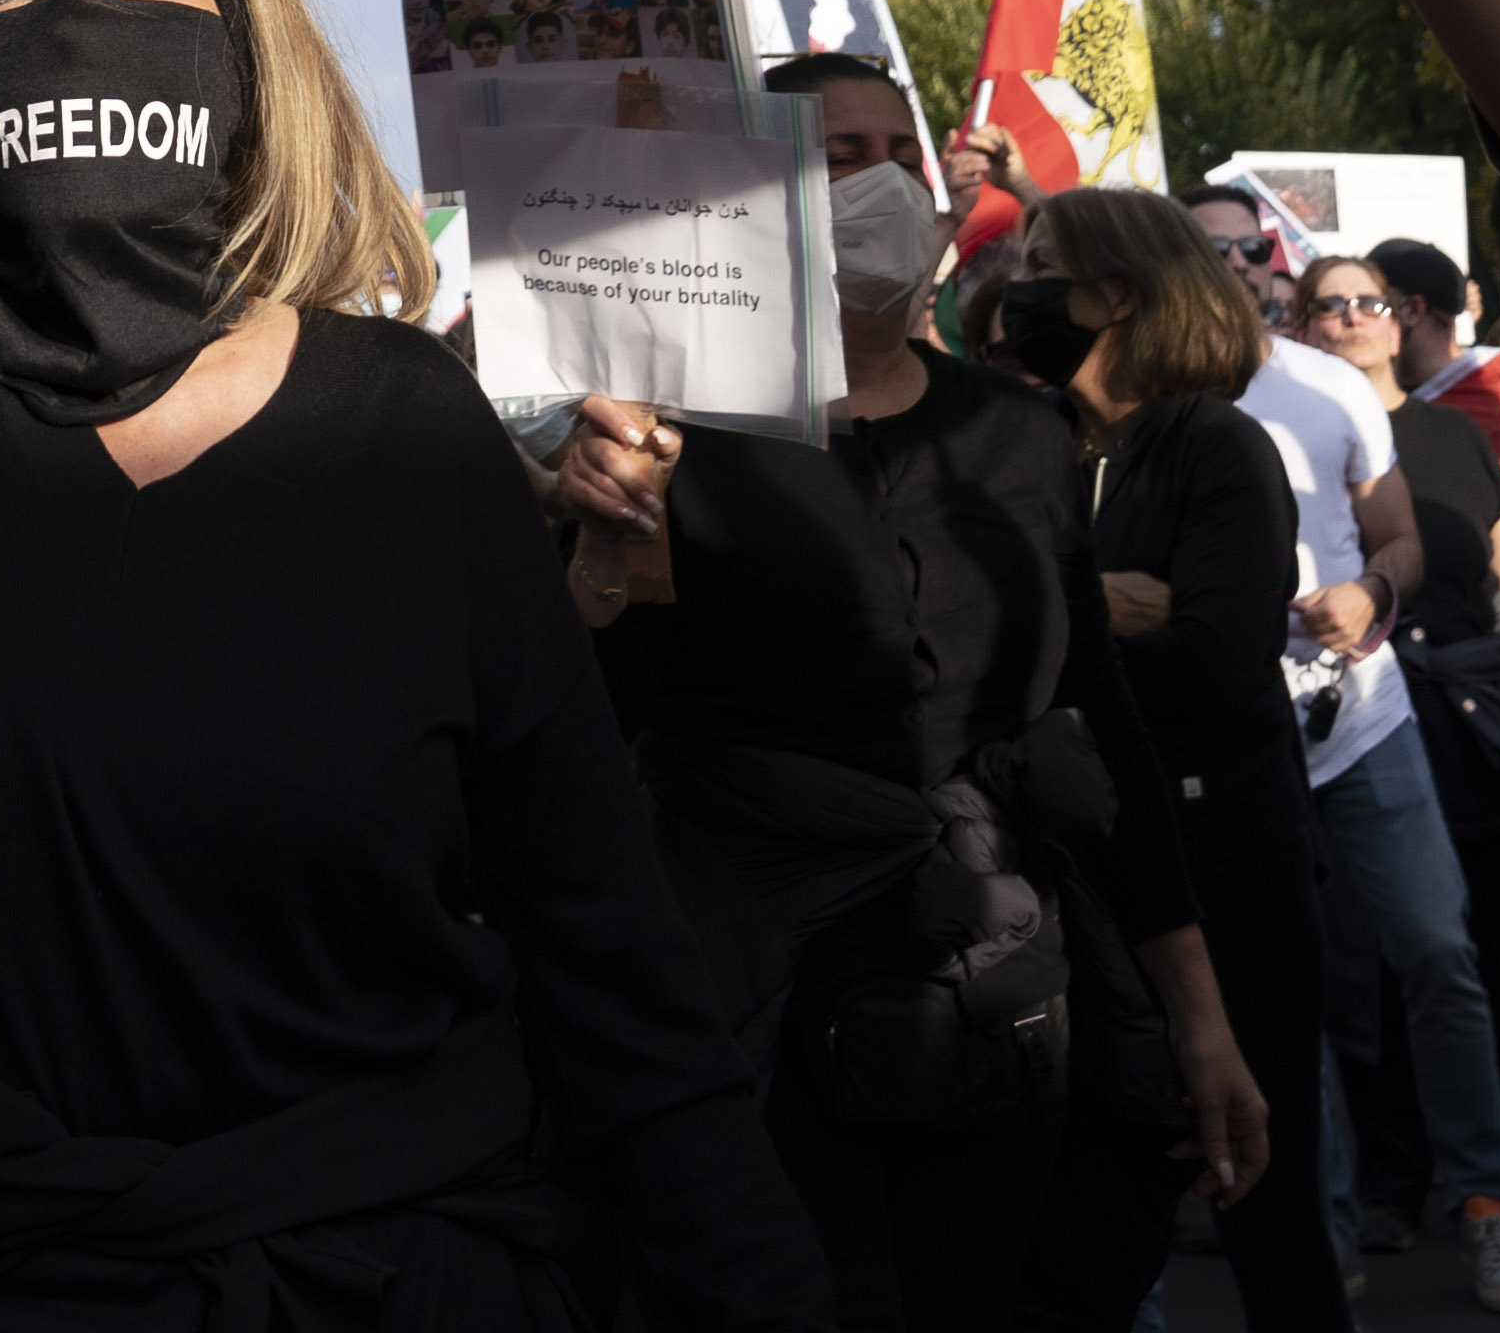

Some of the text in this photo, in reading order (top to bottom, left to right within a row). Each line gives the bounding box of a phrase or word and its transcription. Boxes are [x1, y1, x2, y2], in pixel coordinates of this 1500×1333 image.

[583, 191, 596, 209] از
[645, 196, 661, 212] ما
[664, 197, 713, 218] جوانان
[718, 202, 750, 219] خون
[537, 248, 572, 268] Our
[662, 259, 719, 278] blood
[726, 262, 743, 279] is
[523, 274, 761, 312] because of your brutality
